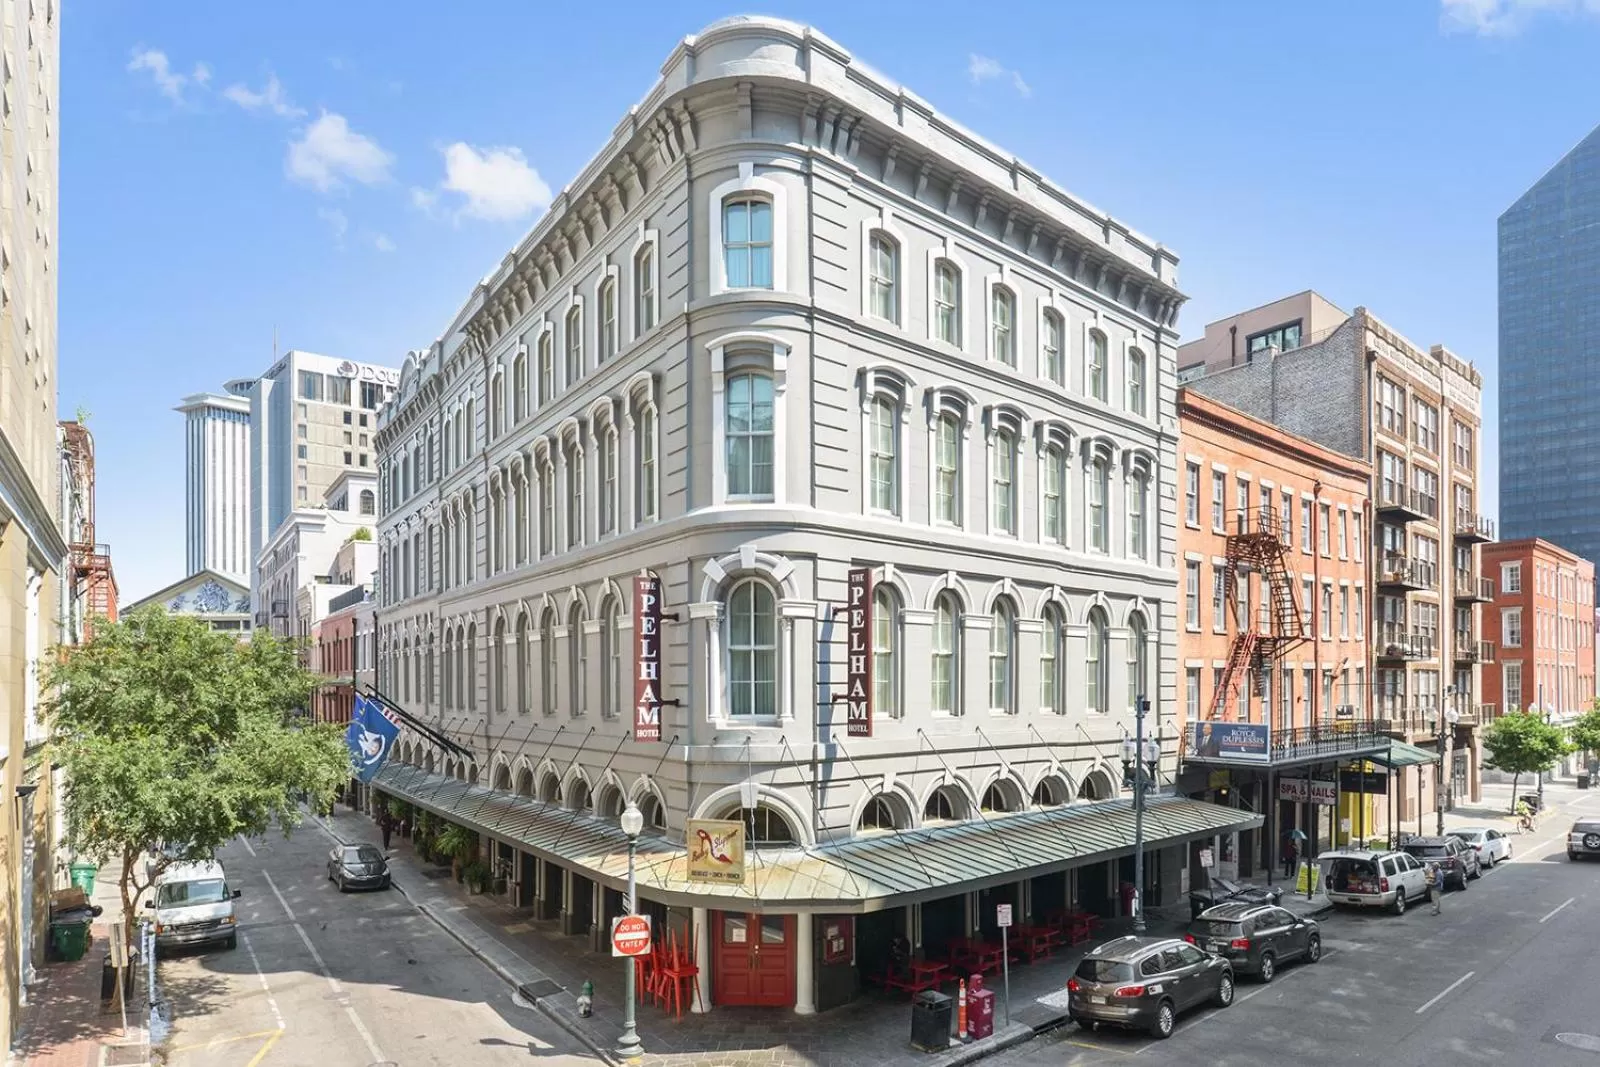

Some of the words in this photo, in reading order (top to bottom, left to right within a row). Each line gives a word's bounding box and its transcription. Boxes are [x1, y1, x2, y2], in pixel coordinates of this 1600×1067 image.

[362, 366, 400, 384] DOU
[851, 573, 864, 582] THE
[639, 581, 656, 590] THE
[848, 586, 868, 720] PELHAM
[637, 594, 660, 725] PELHAM
[848, 723, 868, 733] HOTEL
[636, 729, 660, 738] HOTEL
[1231, 729, 1257, 738] ROYCE
[1280, 783, 1297, 794] SPA
[1309, 787, 1336, 798] NAILS
[631, 922, 645, 931] NOT
[620, 940, 644, 949] ENTER
